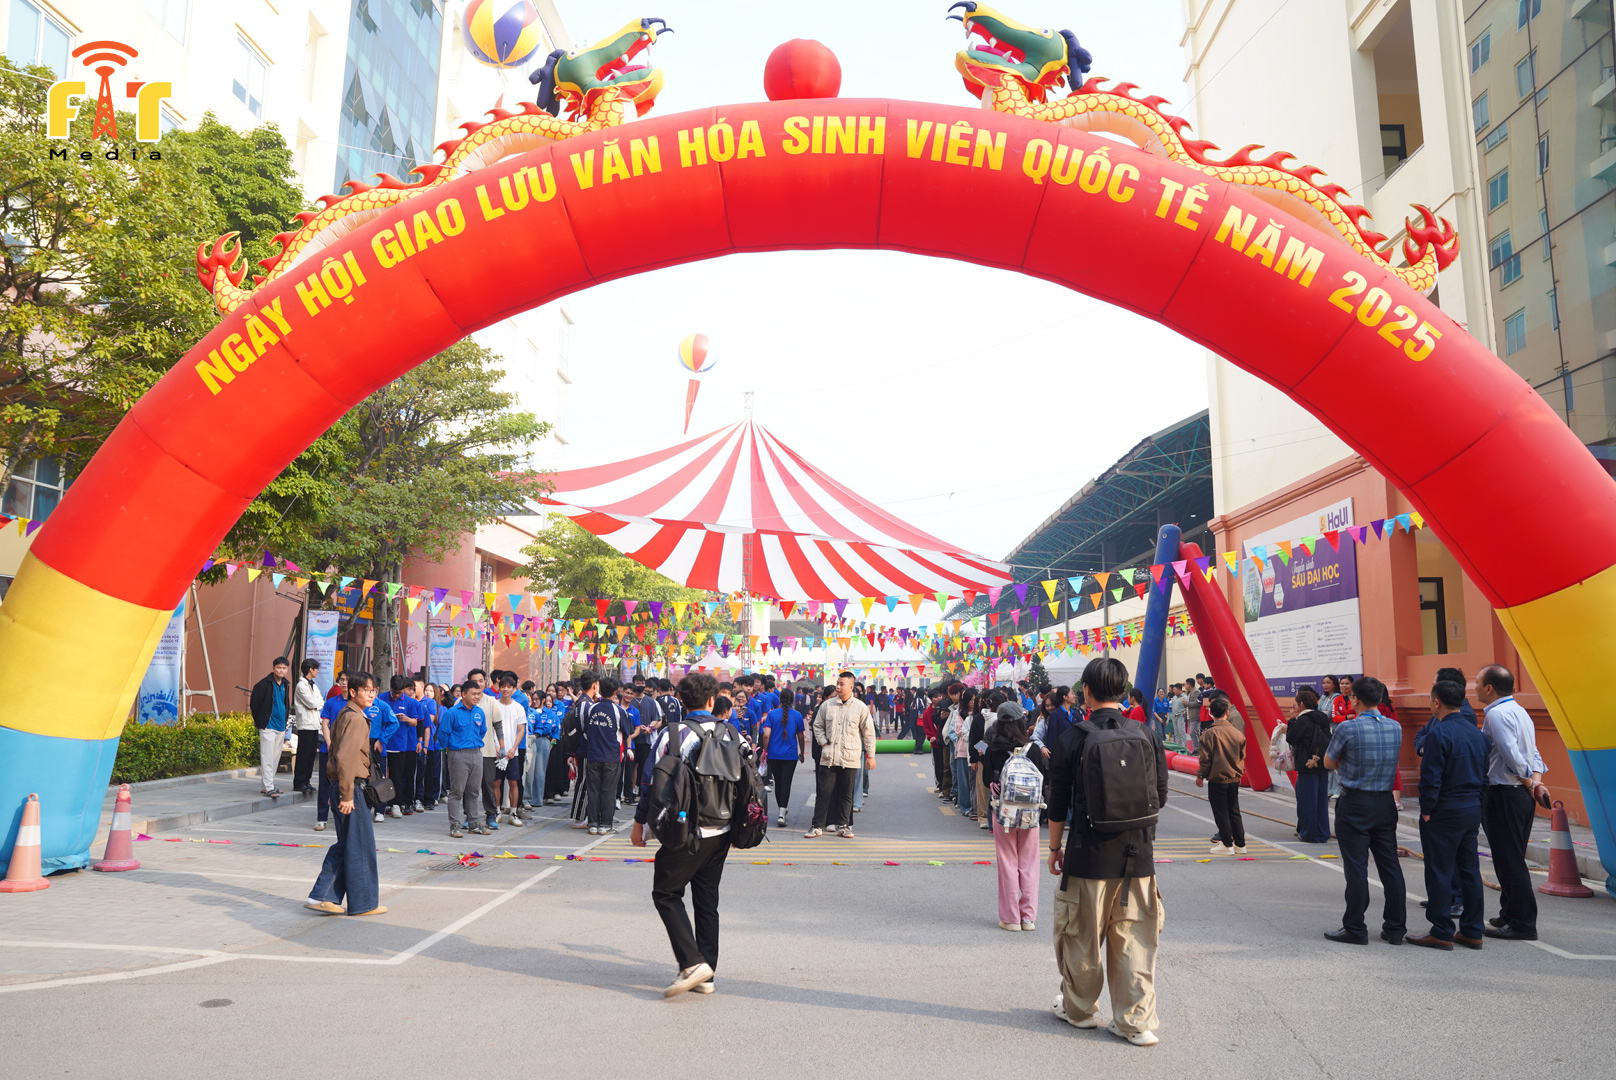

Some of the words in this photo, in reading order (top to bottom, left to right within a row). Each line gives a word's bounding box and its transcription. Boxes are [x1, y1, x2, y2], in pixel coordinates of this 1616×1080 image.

[195, 297, 292, 395] NGÀY
[295, 257, 367, 305] HỘI
[371, 197, 466, 270] GIAO
[475, 162, 557, 222] LƯU
[570, 134, 662, 191] VĂN
[678, 117, 766, 168] HÓA
[782, 116, 886, 155] SINH
[907, 119, 1007, 171] VIÊN
[1022, 138, 1140, 204] QUỐC
[1155, 176, 1211, 231] TẾ
[1214, 205, 1325, 288] NĂM
[1328, 271, 1443, 361] 2025
[1327, 506, 1348, 530] HaUI
[1292, 572, 1306, 589] SAU
[1307, 568, 1321, 587] ĐẠI
[1322, 563, 1340, 583] HỌC
